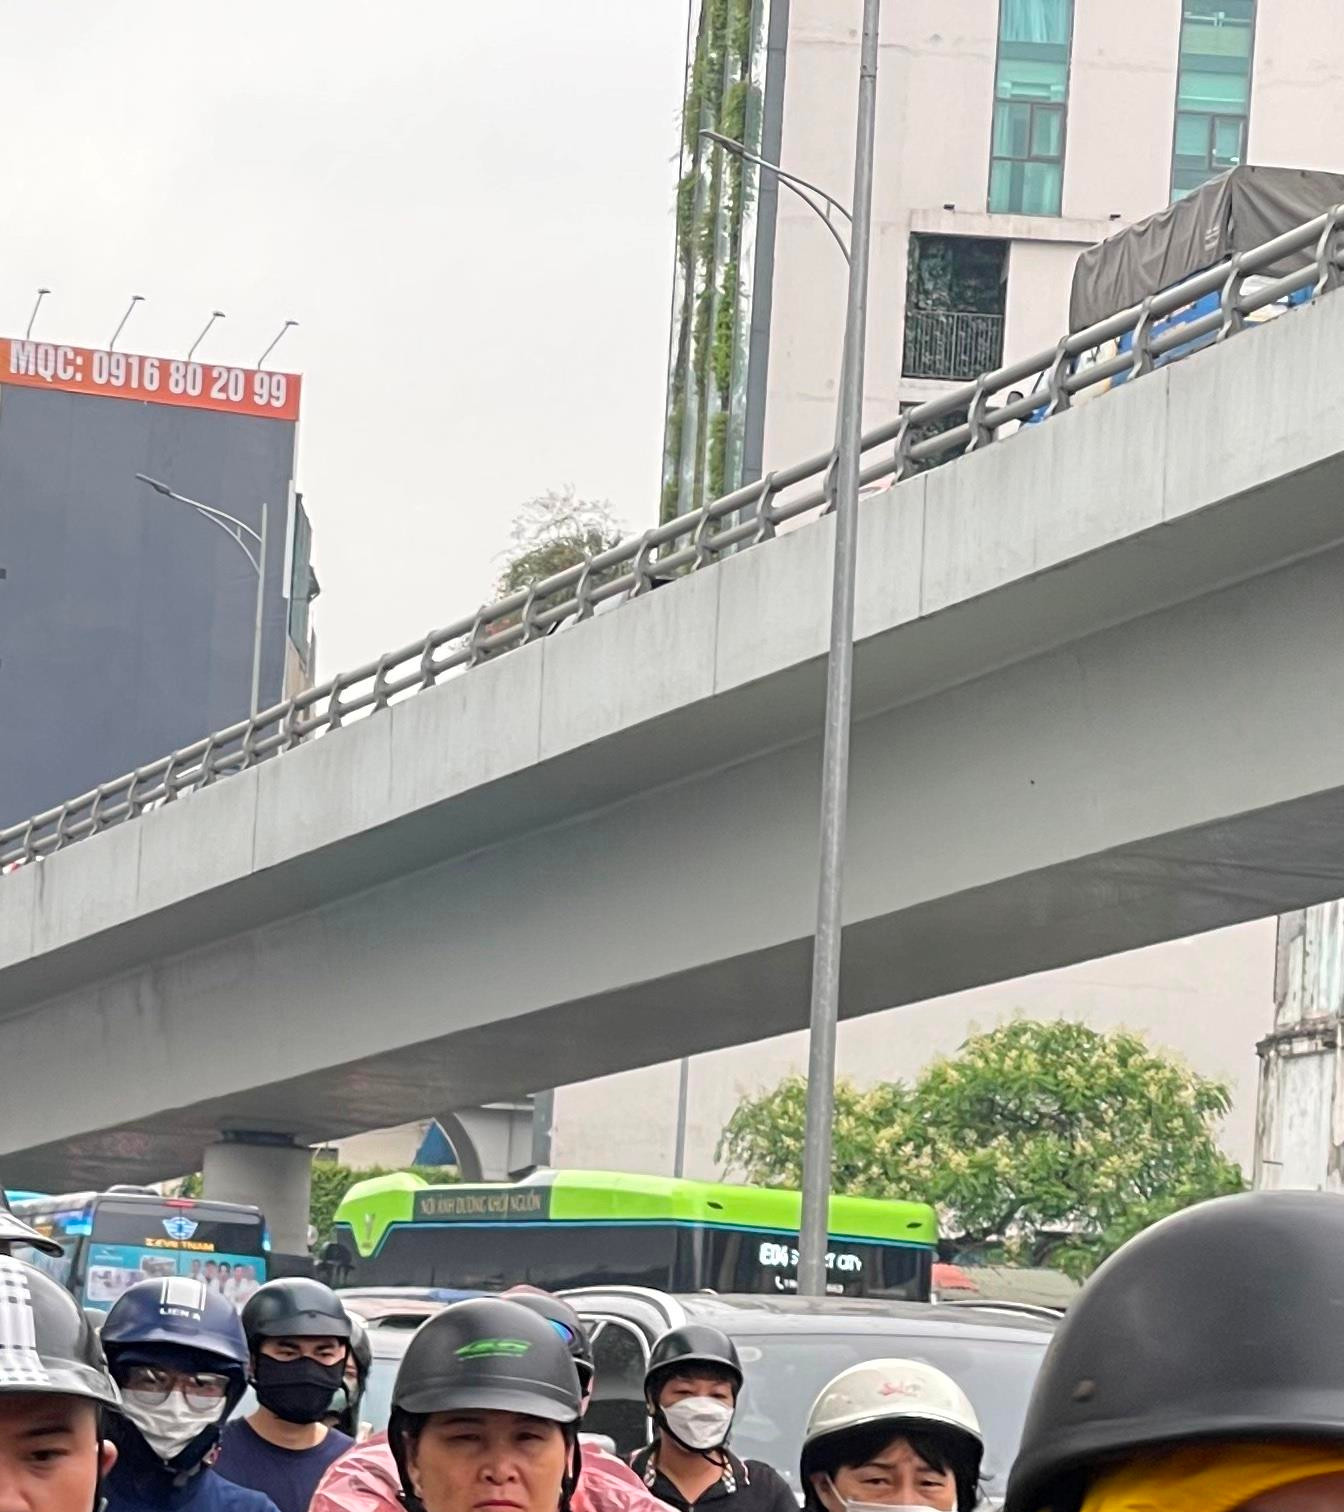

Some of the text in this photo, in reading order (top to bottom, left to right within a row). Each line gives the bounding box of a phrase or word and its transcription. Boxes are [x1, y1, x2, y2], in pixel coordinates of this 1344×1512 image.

[9, 340, 287, 408] MQC: 0916 80 20 99
